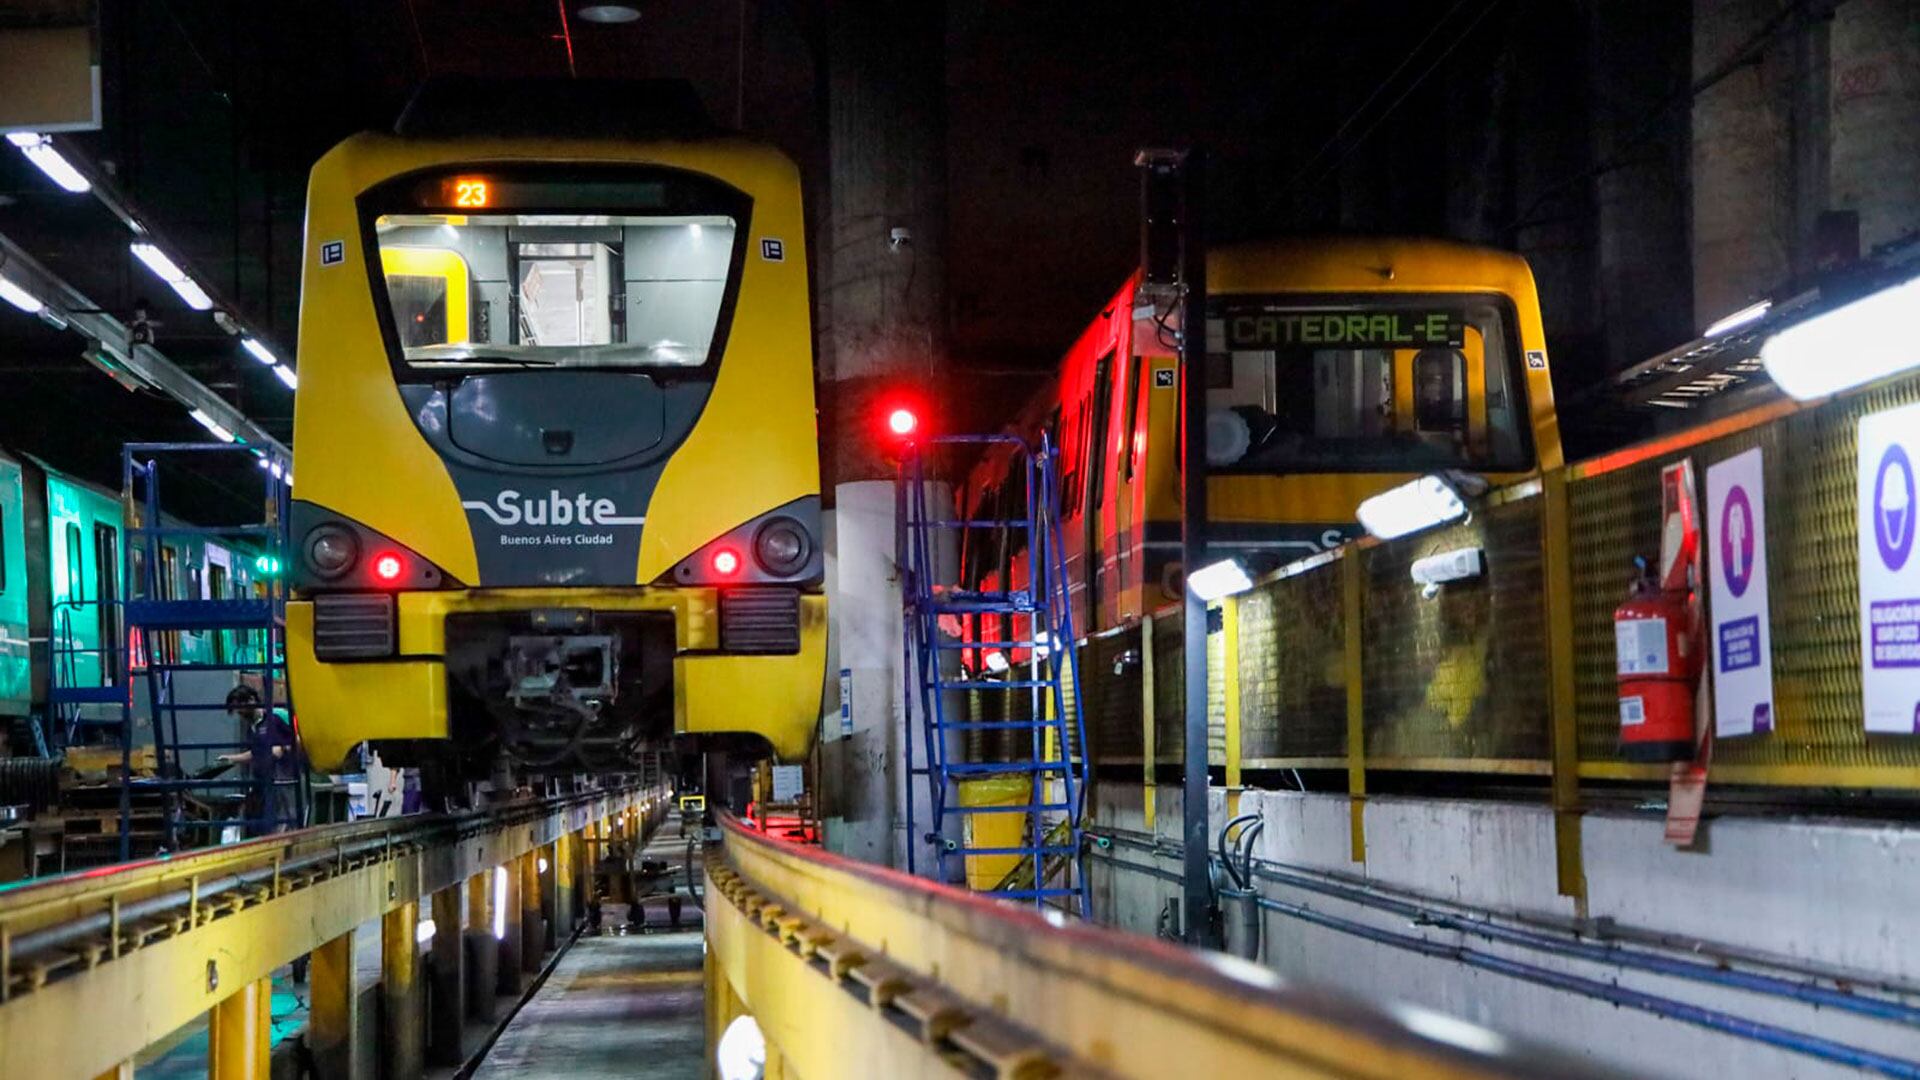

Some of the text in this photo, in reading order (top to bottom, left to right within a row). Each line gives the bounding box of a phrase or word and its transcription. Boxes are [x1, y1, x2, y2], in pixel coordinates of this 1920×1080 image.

[457, 181, 487, 206] 23
[496, 489, 618, 526] Subte
[500, 533, 613, 545] Buenos Aires Ciudad
